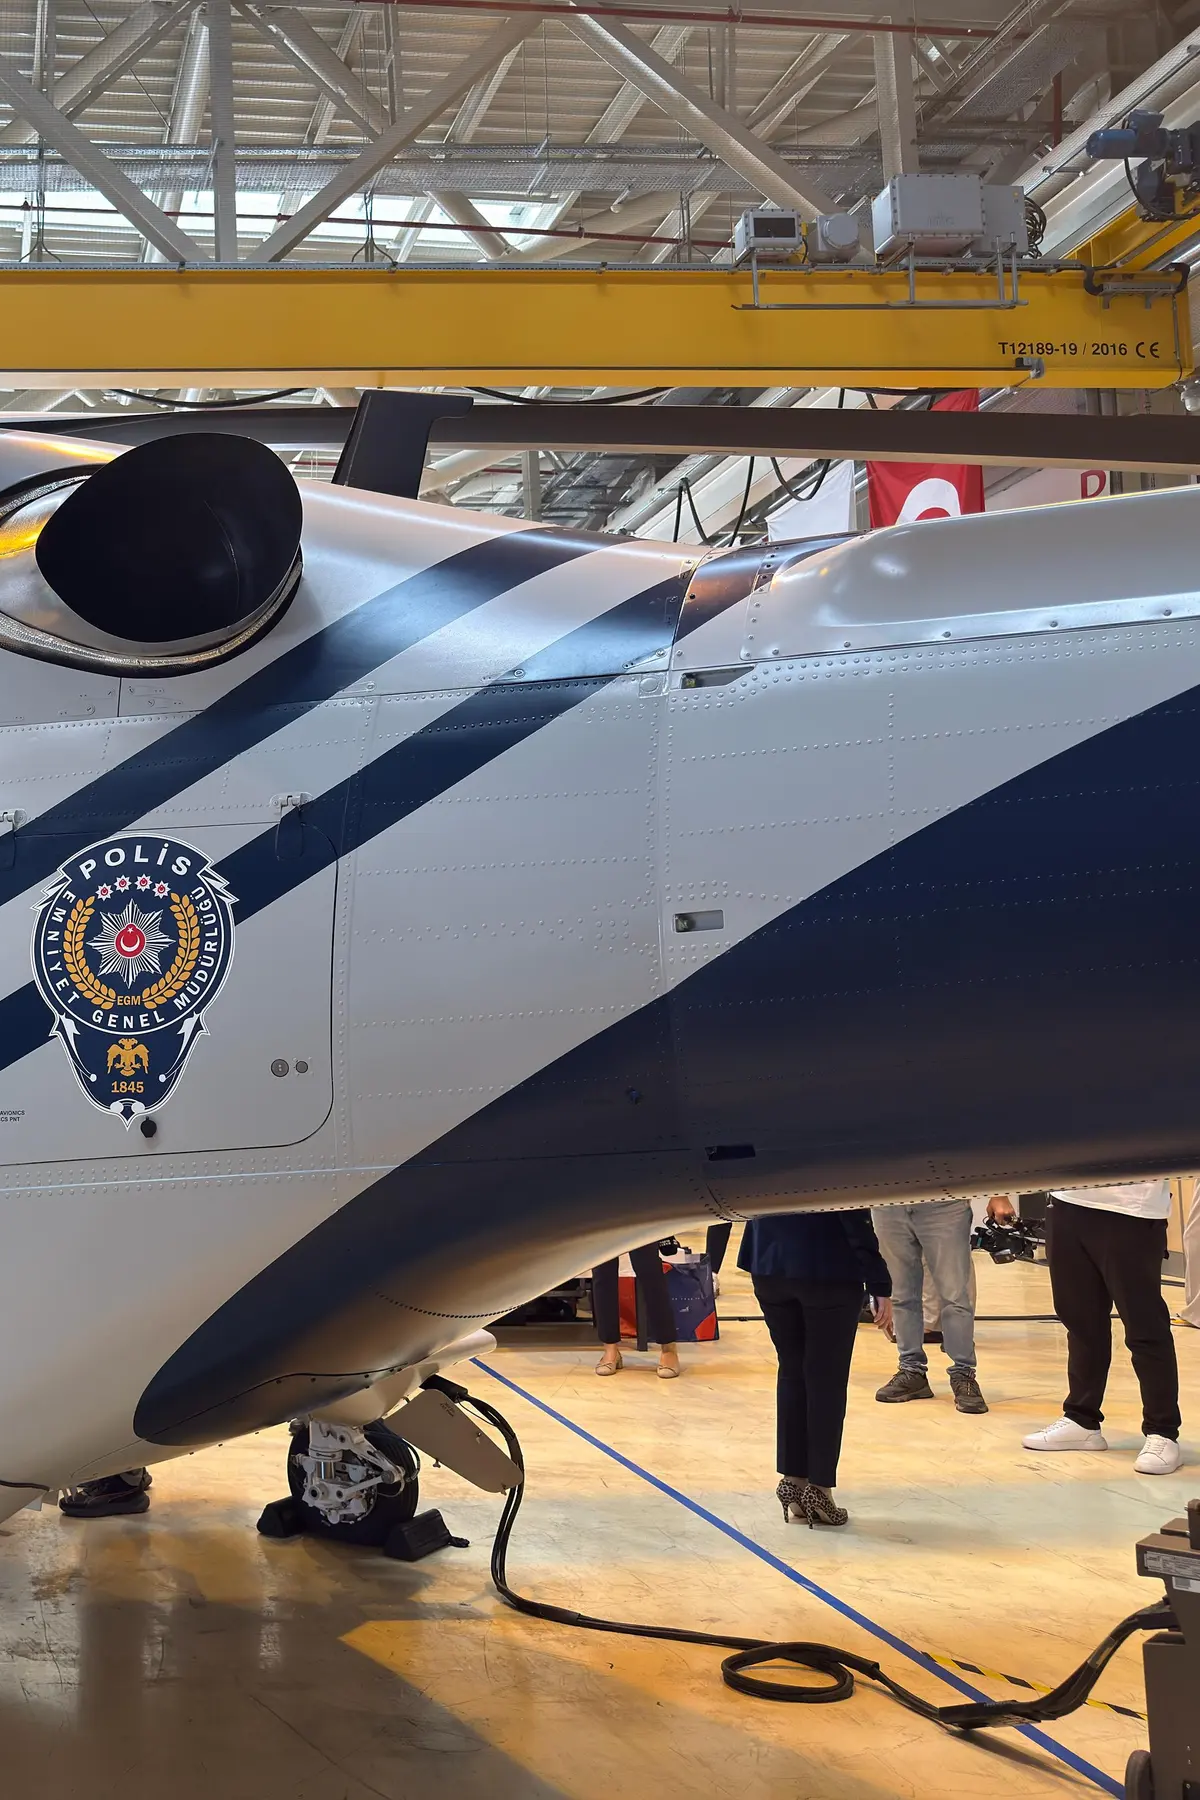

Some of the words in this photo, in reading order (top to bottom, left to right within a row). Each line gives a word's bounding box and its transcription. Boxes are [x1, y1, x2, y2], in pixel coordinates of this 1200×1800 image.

[998, 342, 1077, 356] T12189-19
[1082, 342, 1087, 356] /
[1091, 342, 1128, 356] 2016
[78, 842, 192, 880] POLİS
[47, 890, 80, 1004] EMNİYET
[91, 1009, 165, 1029] GENEL
[173, 886, 218, 1010] MÜDÜRLÜĞÜ
[117, 995, 141, 1006] EGM
[111, 1081, 144, 1094] 1845
